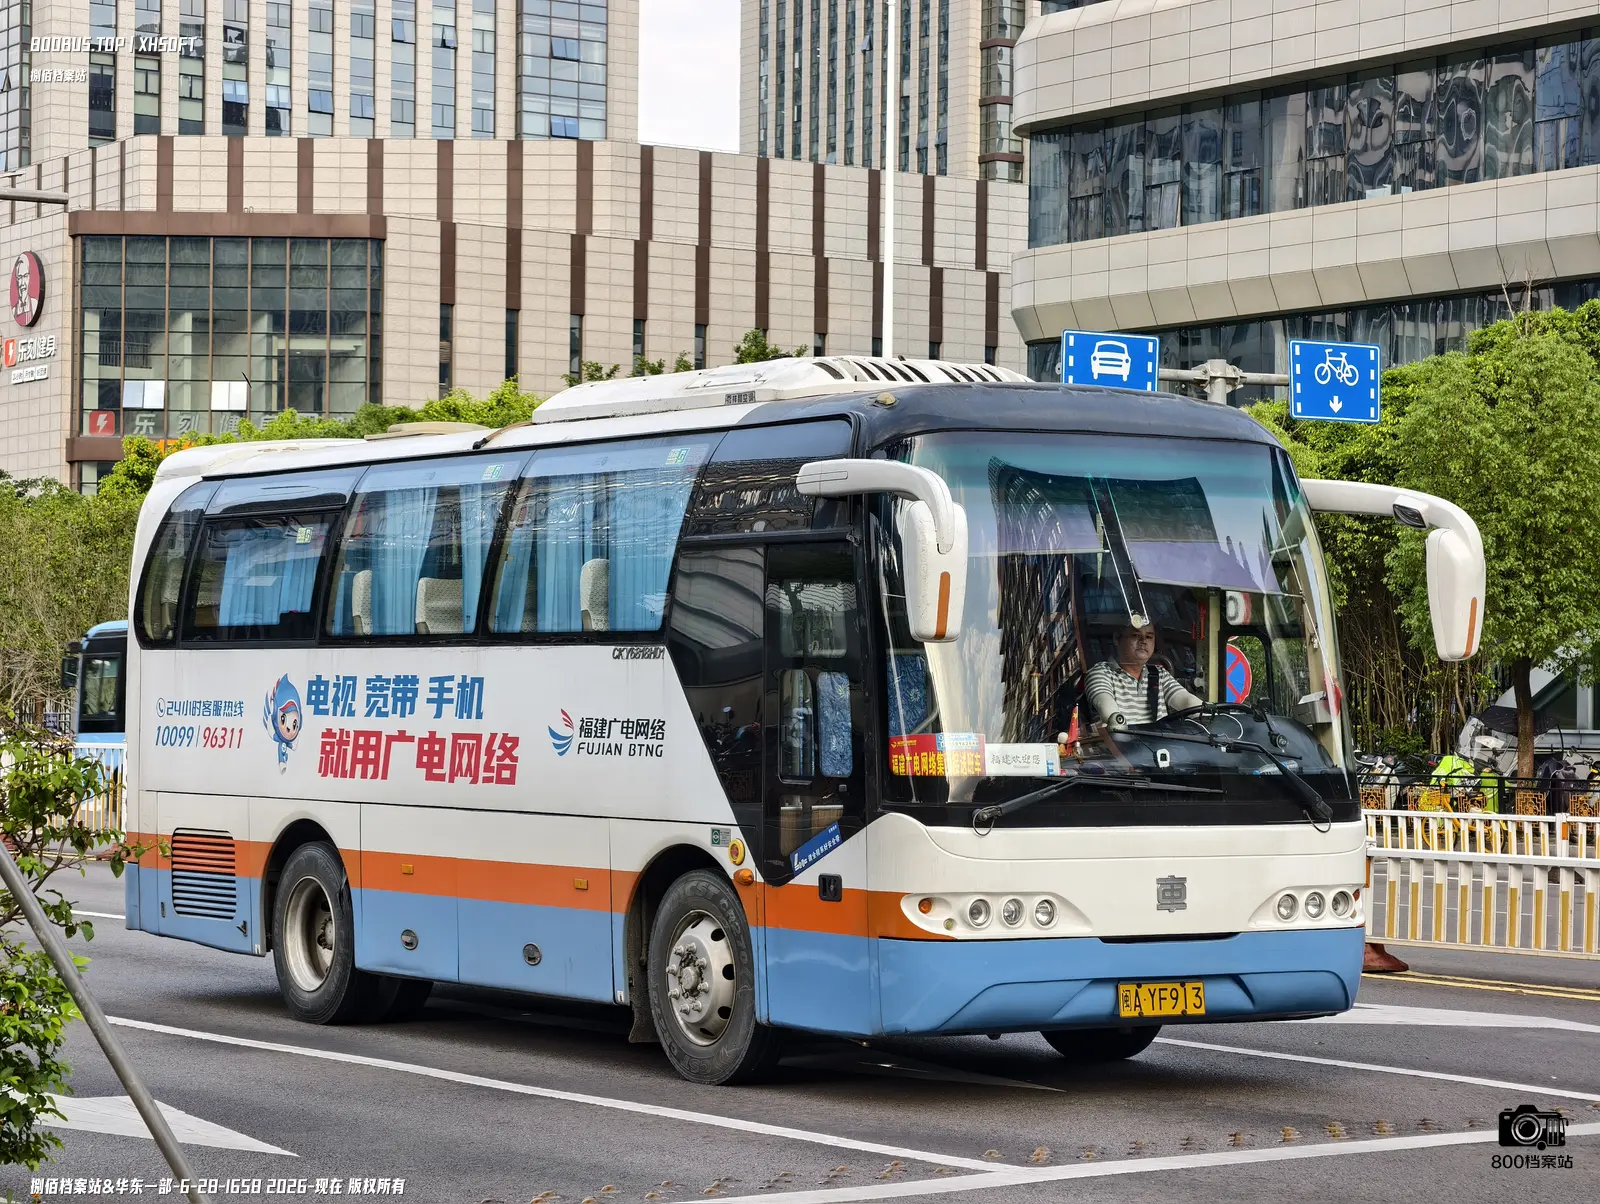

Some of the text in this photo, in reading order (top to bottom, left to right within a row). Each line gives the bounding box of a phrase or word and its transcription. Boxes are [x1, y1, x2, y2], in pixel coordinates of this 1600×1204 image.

[17, 334, 57, 363] 乐刻健身
[166, 700, 244, 718] 24小时客服热线
[306, 674, 485, 720] 电视 宽带 手机
[155, 725, 244, 749] 10099 96311
[579, 717, 666, 741] 福建广电网络
[318, 727, 520, 786] 就用广电网络
[577, 742, 663, 758] FUJIAN BTNG
[991, 754, 1041, 765] 福建欢迎您
